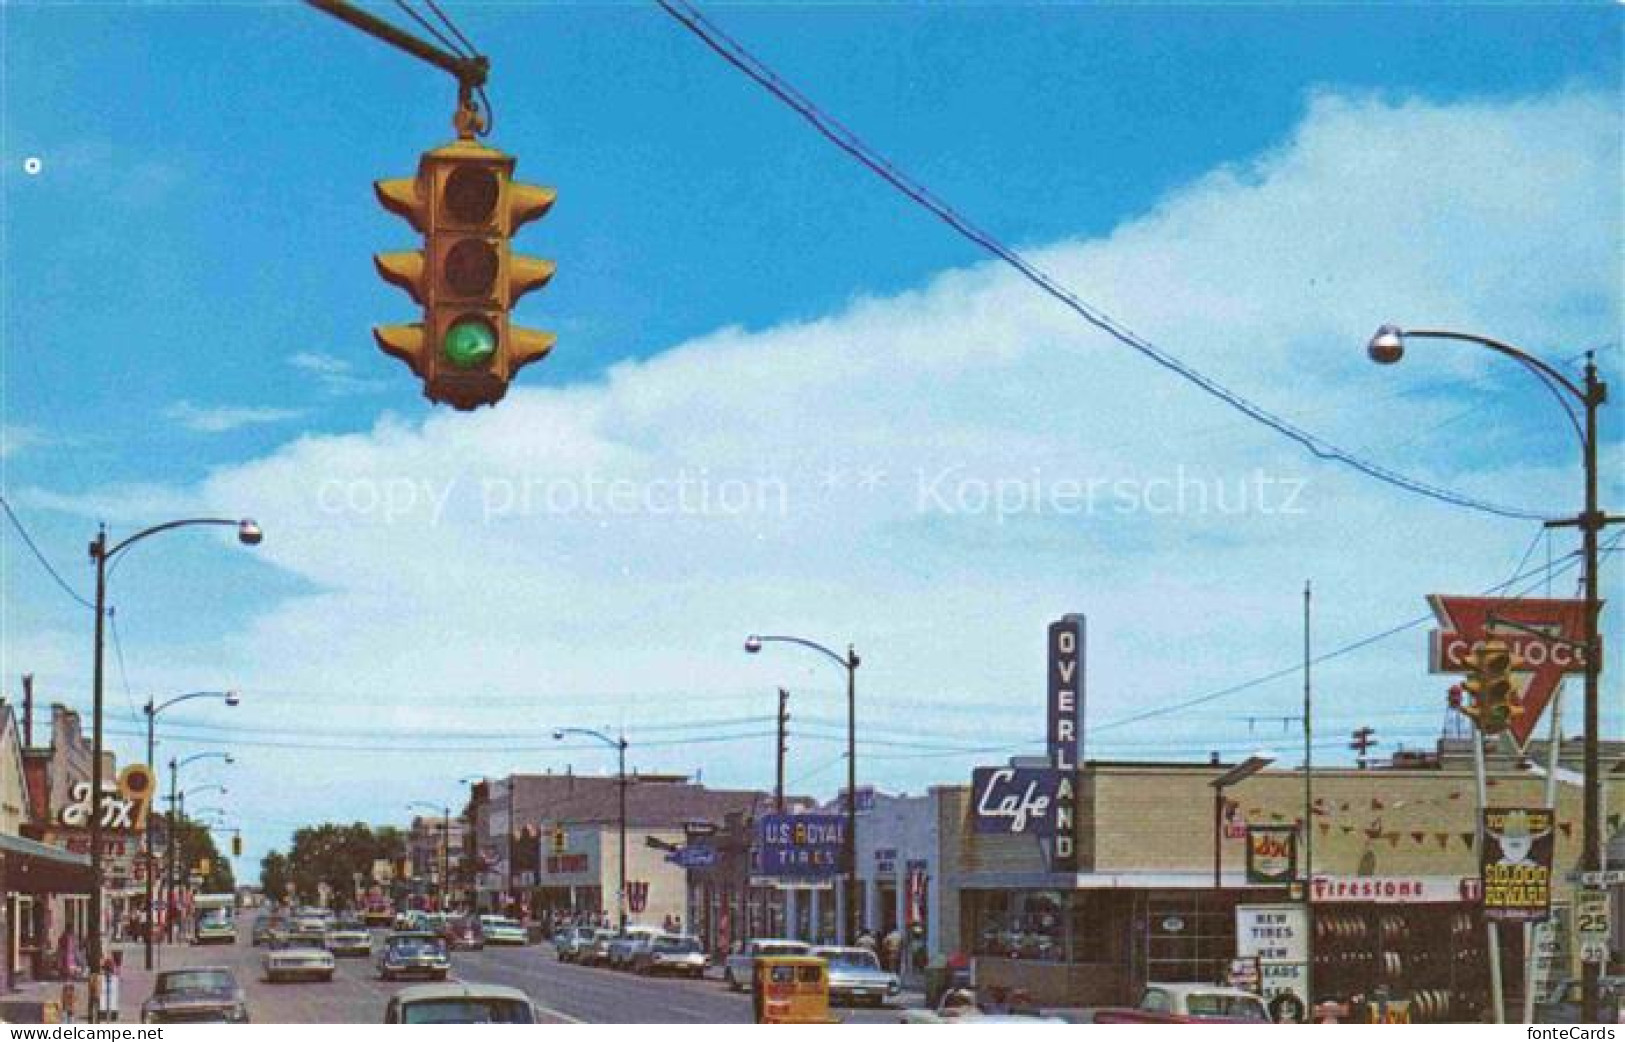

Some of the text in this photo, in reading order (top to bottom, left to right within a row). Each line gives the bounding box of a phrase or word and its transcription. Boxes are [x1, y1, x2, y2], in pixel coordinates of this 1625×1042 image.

[1056, 631, 1076, 858] OVERLAND
[978, 769, 1050, 833] Cafe
[795, 822, 844, 844] ROYAL
[778, 850, 835, 865] TIRES
[1312, 878, 1423, 897] Firestone
[1256, 914, 1287, 925] NEW
[1579, 914, 1607, 932] 25
[1250, 927, 1294, 939] TIRES
